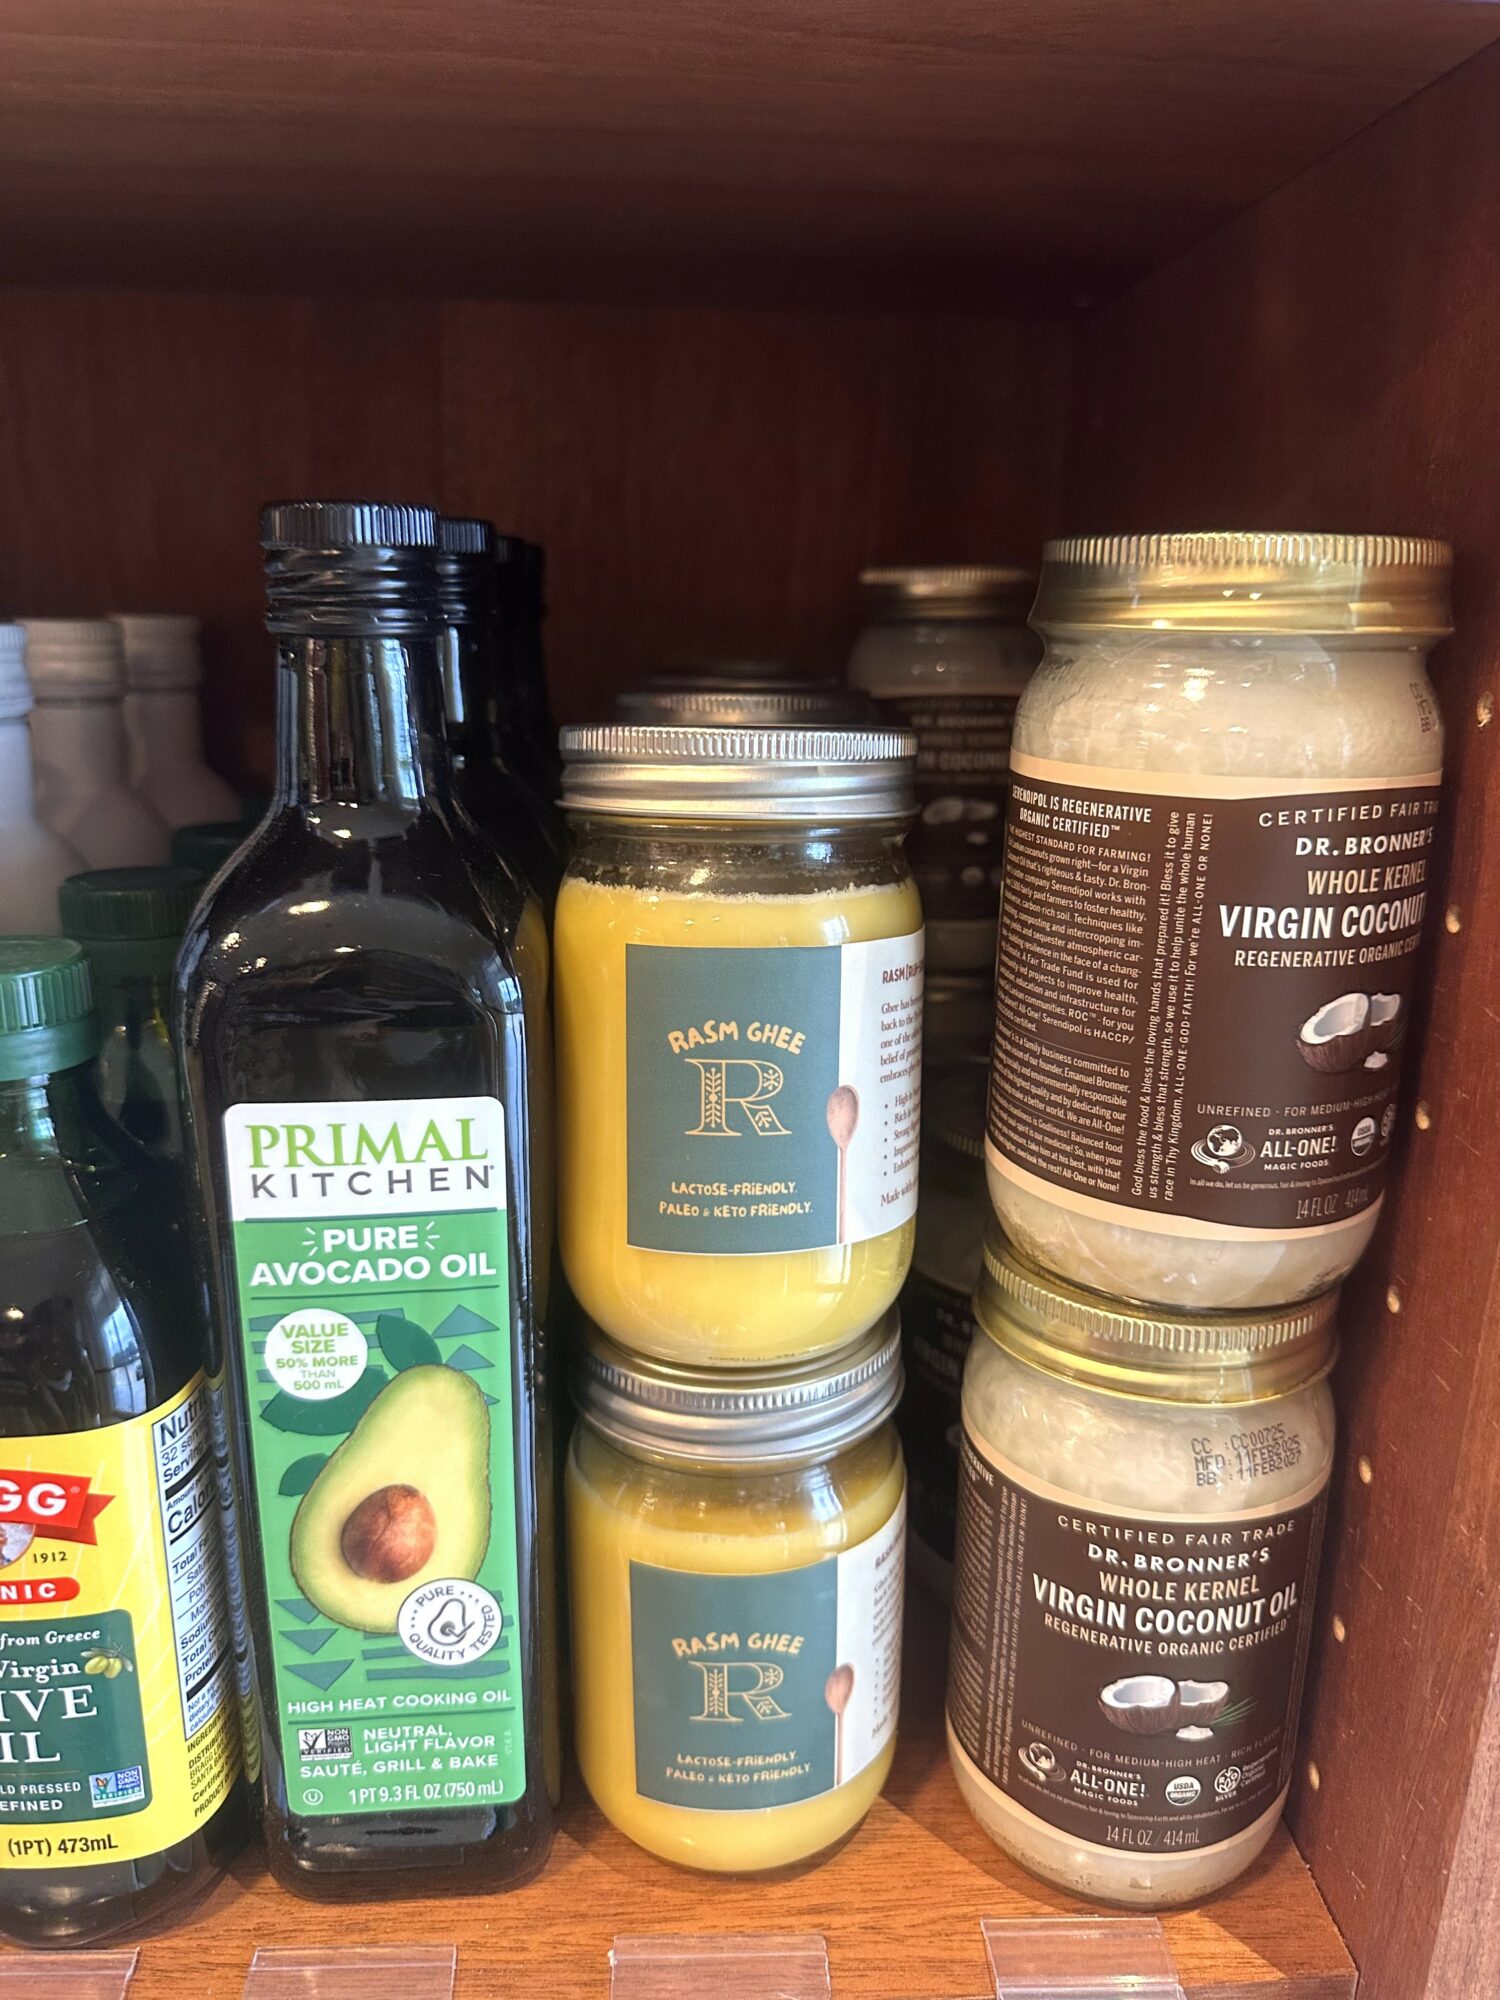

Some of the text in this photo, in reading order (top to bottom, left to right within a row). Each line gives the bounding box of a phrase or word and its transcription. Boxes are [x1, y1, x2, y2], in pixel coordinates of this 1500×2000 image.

[1012, 785, 1152, 823] SERENDIPOL IS REGENERATIVE
[1259, 801, 1418, 827] CERTIFIED FAIR
[1020, 808, 1049, 828] ORGANIC
[1169, 811, 1180, 836] give
[1036, 833, 1151, 862] STANDARD FOR FARMING!
[1178, 812, 1196, 886] whole human
[1198, 813, 1213, 871] OR NONE!
[1295, 827, 1433, 856] DR. BRONNER'S
[1307, 859, 1426, 895] WHOLE KERNEL
[1051, 880, 1146, 906] Serendipol works with
[1219, 905, 1334, 939] VIRGIN
[1234, 943, 1402, 968] REGENERATIVE ORGANIC
[1096, 973, 1139, 990] used for
[882, 1003, 899, 1014] Ghee
[667, 1019, 807, 1055] RASM GHEE
[881, 1020, 896, 1031] back
[1093, 1029, 1135, 1045] HACCP/
[881, 1038, 893, 1049] one
[684, 1058, 793, 1137] R
[1197, 1104, 1271, 1118] UNREFINED
[1284, 1105, 1306, 1117] FOR
[1269, 1124, 1334, 1136] DR. BRONNER'S
[245, 1118, 488, 1168] PRIMAL
[1260, 1135, 1336, 1158] ALL-ONE!
[1264, 1159, 1329, 1171] MAGIC FOODS
[251, 1165, 491, 1198] KITCHEN
[659, 1201, 699, 1217] PALEO
[713, 1202, 747, 1217] KETO
[1296, 1200, 1308, 1219] 14
[1311, 1197, 1322, 1217] FL
[1324, 1194, 1338, 1214] OZ
[323, 1225, 418, 1253] PURE
[250, 1252, 497, 1287] AVOCADO OIL
[281, 1323, 349, 1339] VALUE
[291, 1340, 335, 1354] SIZE
[276, 1356, 358, 1369] 50% MORE
[300, 1370, 335, 1379] THAN
[292, 1380, 344, 1391] 500 mL
[1058, 1515, 1296, 1545] CERTIFIED FAIR TRADE
[34, 1551, 67, 1563] 1912
[1088, 1543, 1270, 1572] DR. BRONNER'S
[0, 1583, 57, 1599] NIC
[416, 1586, 454, 1607] PURE
[1100, 1571, 1260, 1601] WHOLE KERNEL
[1033, 1573, 1297, 1635] VIRGIN COCONUT OIL
[0, 1630, 100, 1650] from Greece
[409, 1605, 495, 1660] QUALITY TESTED
[672, 1632, 805, 1657] RASM GHEE
[1044, 1613, 1287, 1656] REGENERATIVE ORGANIC CERTIFIED
[288, 1690, 511, 1714] HIGH HEAT COOKING OIL
[688, 1661, 792, 1721] R
[364, 1725, 452, 1740] NEUTRAL,
[365, 1739, 416, 1754] LIGHT
[423, 1735, 495, 1750] FLAVOR
[1022, 1720, 1077, 1751] UNREFINED
[1090, 1749, 1110, 1760] FOR
[1115, 1754, 1192, 1768] MEDIUM-HIGH
[1196, 1755, 1220, 1766] HEAT
[0, 1731, 61, 1763] IL
[300, 1754, 498, 1778] SAUTÉ, GRILL & BAKE
[666, 1767, 705, 1781] PALEO
[718, 1773, 749, 1783] KETO
[1076, 1760, 1141, 1780] DR. BRONNER'S
[20, 1781, 81, 1795] PRESSED
[350, 1780, 504, 1804] 1 PT 9.3 FL OZ (750 mL)
[1070, 1769, 1145, 1797] ALL-ONE!
[1174, 1782, 1194, 1790] USDA
[0, 1799, 63, 1811] EFINED
[194, 1783, 226, 1817] PRODUCT
[1074, 1786, 1138, 1806] MAGIC FOODS
[8, 1834, 118, 1857] (1PT) 473mL
[1106, 1825, 1200, 1846] 14 FL OZ 414 mL
